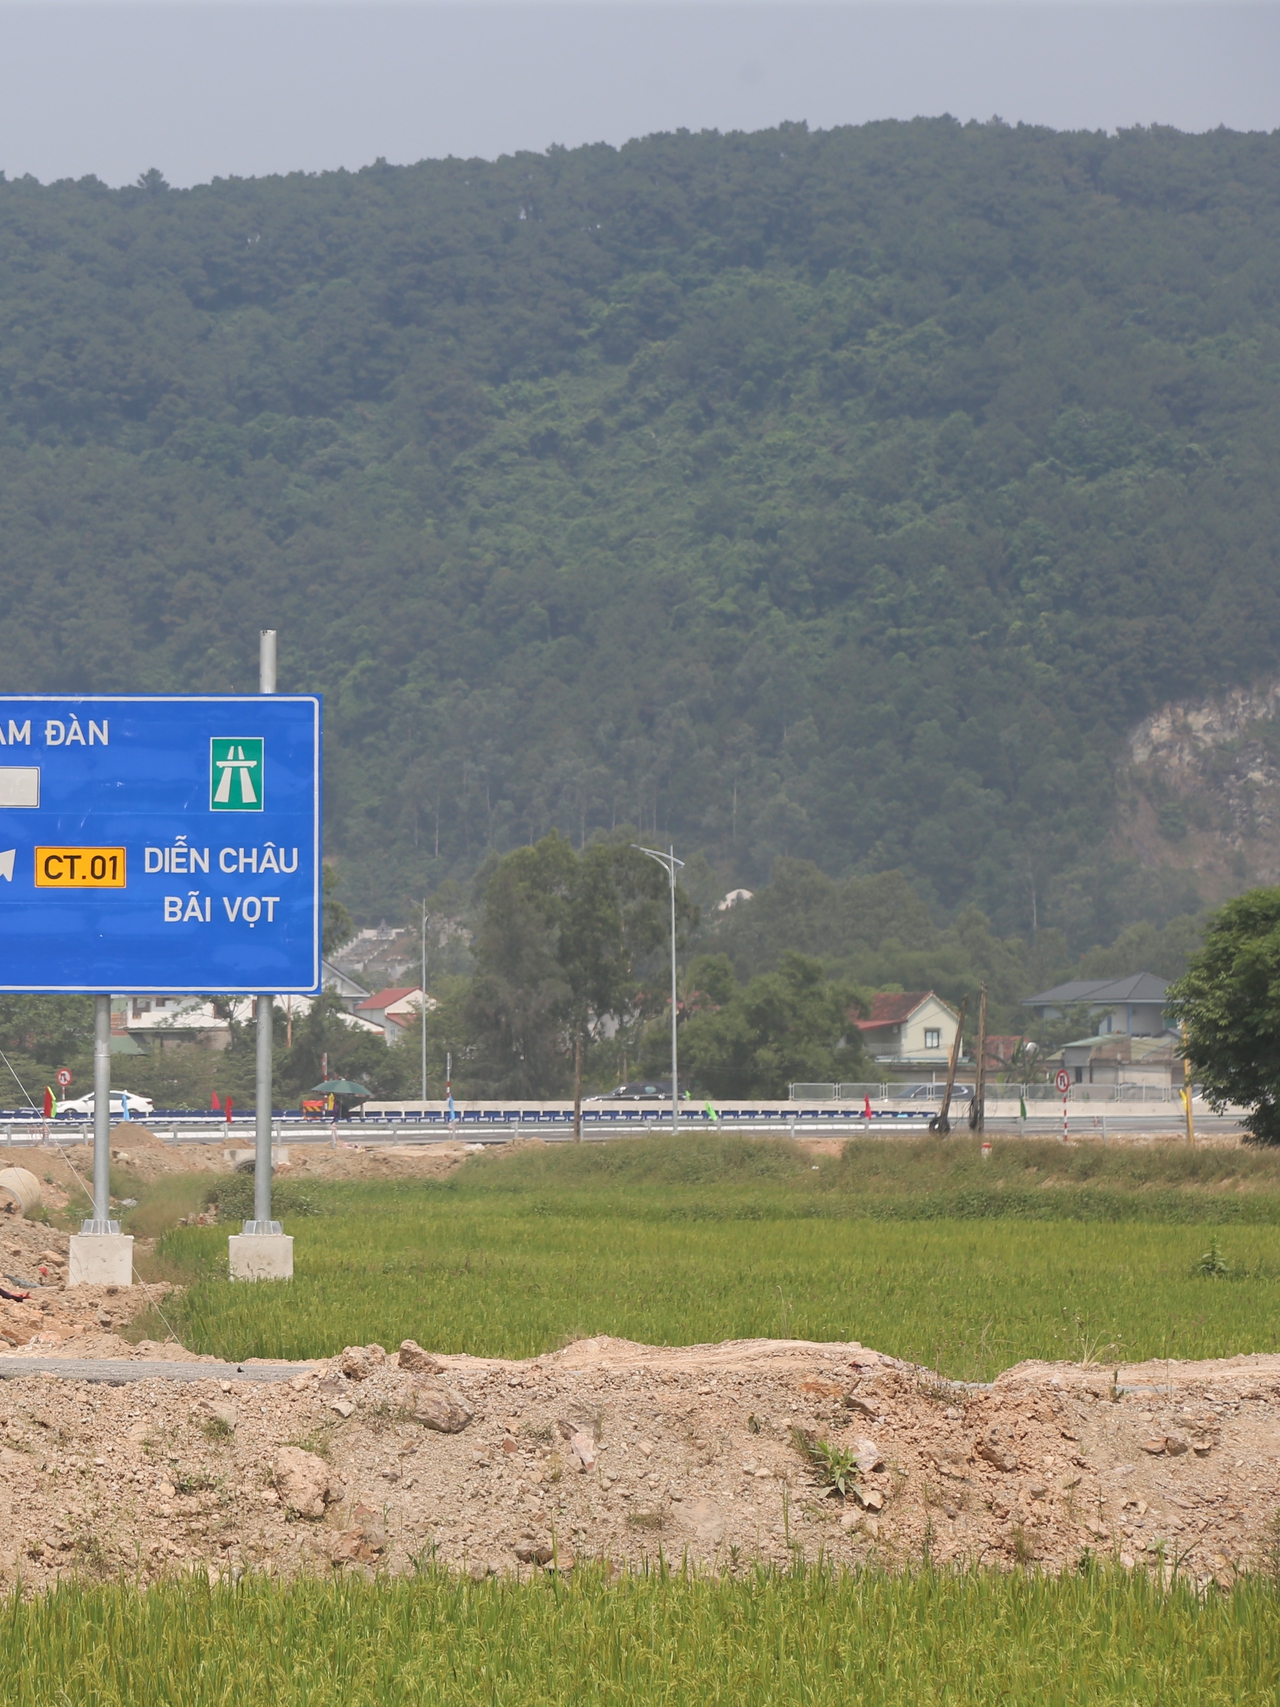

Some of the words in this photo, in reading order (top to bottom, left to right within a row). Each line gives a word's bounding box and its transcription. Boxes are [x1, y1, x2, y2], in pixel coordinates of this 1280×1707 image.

[44, 713, 109, 746] ĐÀN
[43, 855, 118, 880] CT.01
[144, 835, 210, 874] DIỄN
[219, 841, 299, 874] CHÂU
[164, 891, 211, 922] BÃI
[222, 896, 280, 928] VỌT
